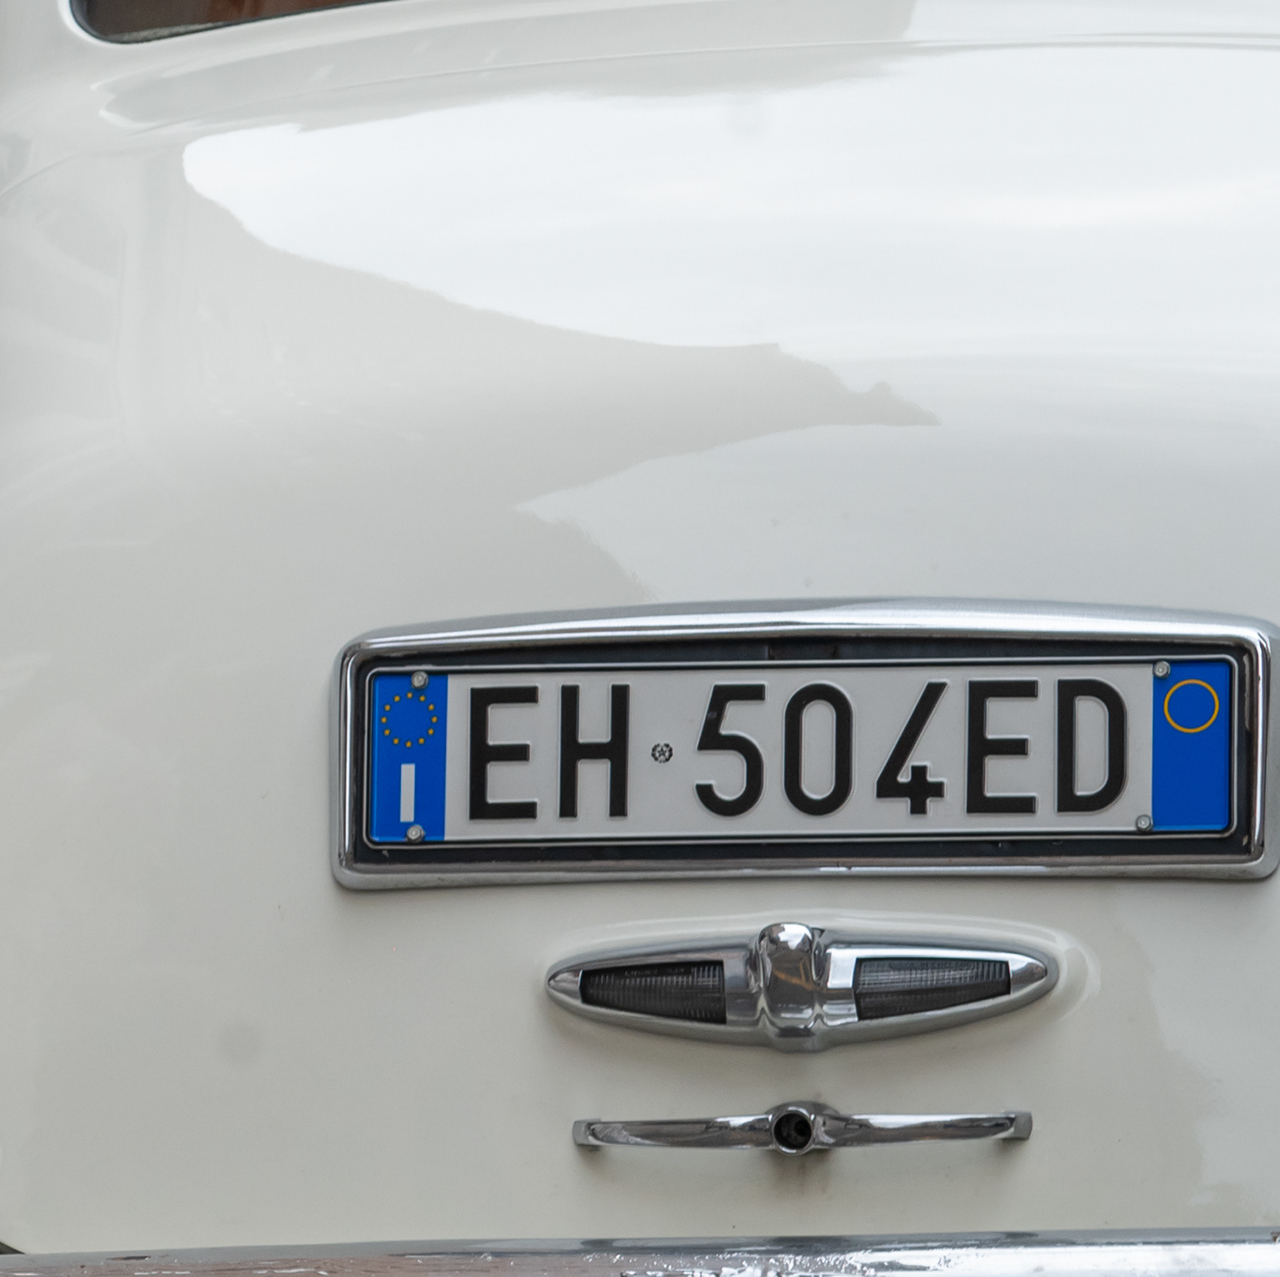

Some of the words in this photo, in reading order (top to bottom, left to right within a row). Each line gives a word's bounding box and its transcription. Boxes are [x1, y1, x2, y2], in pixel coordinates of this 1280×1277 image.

[399, 763, 416, 823] I
[468, 683, 629, 822] EH
[694, 678, 1129, 818] 504ED
